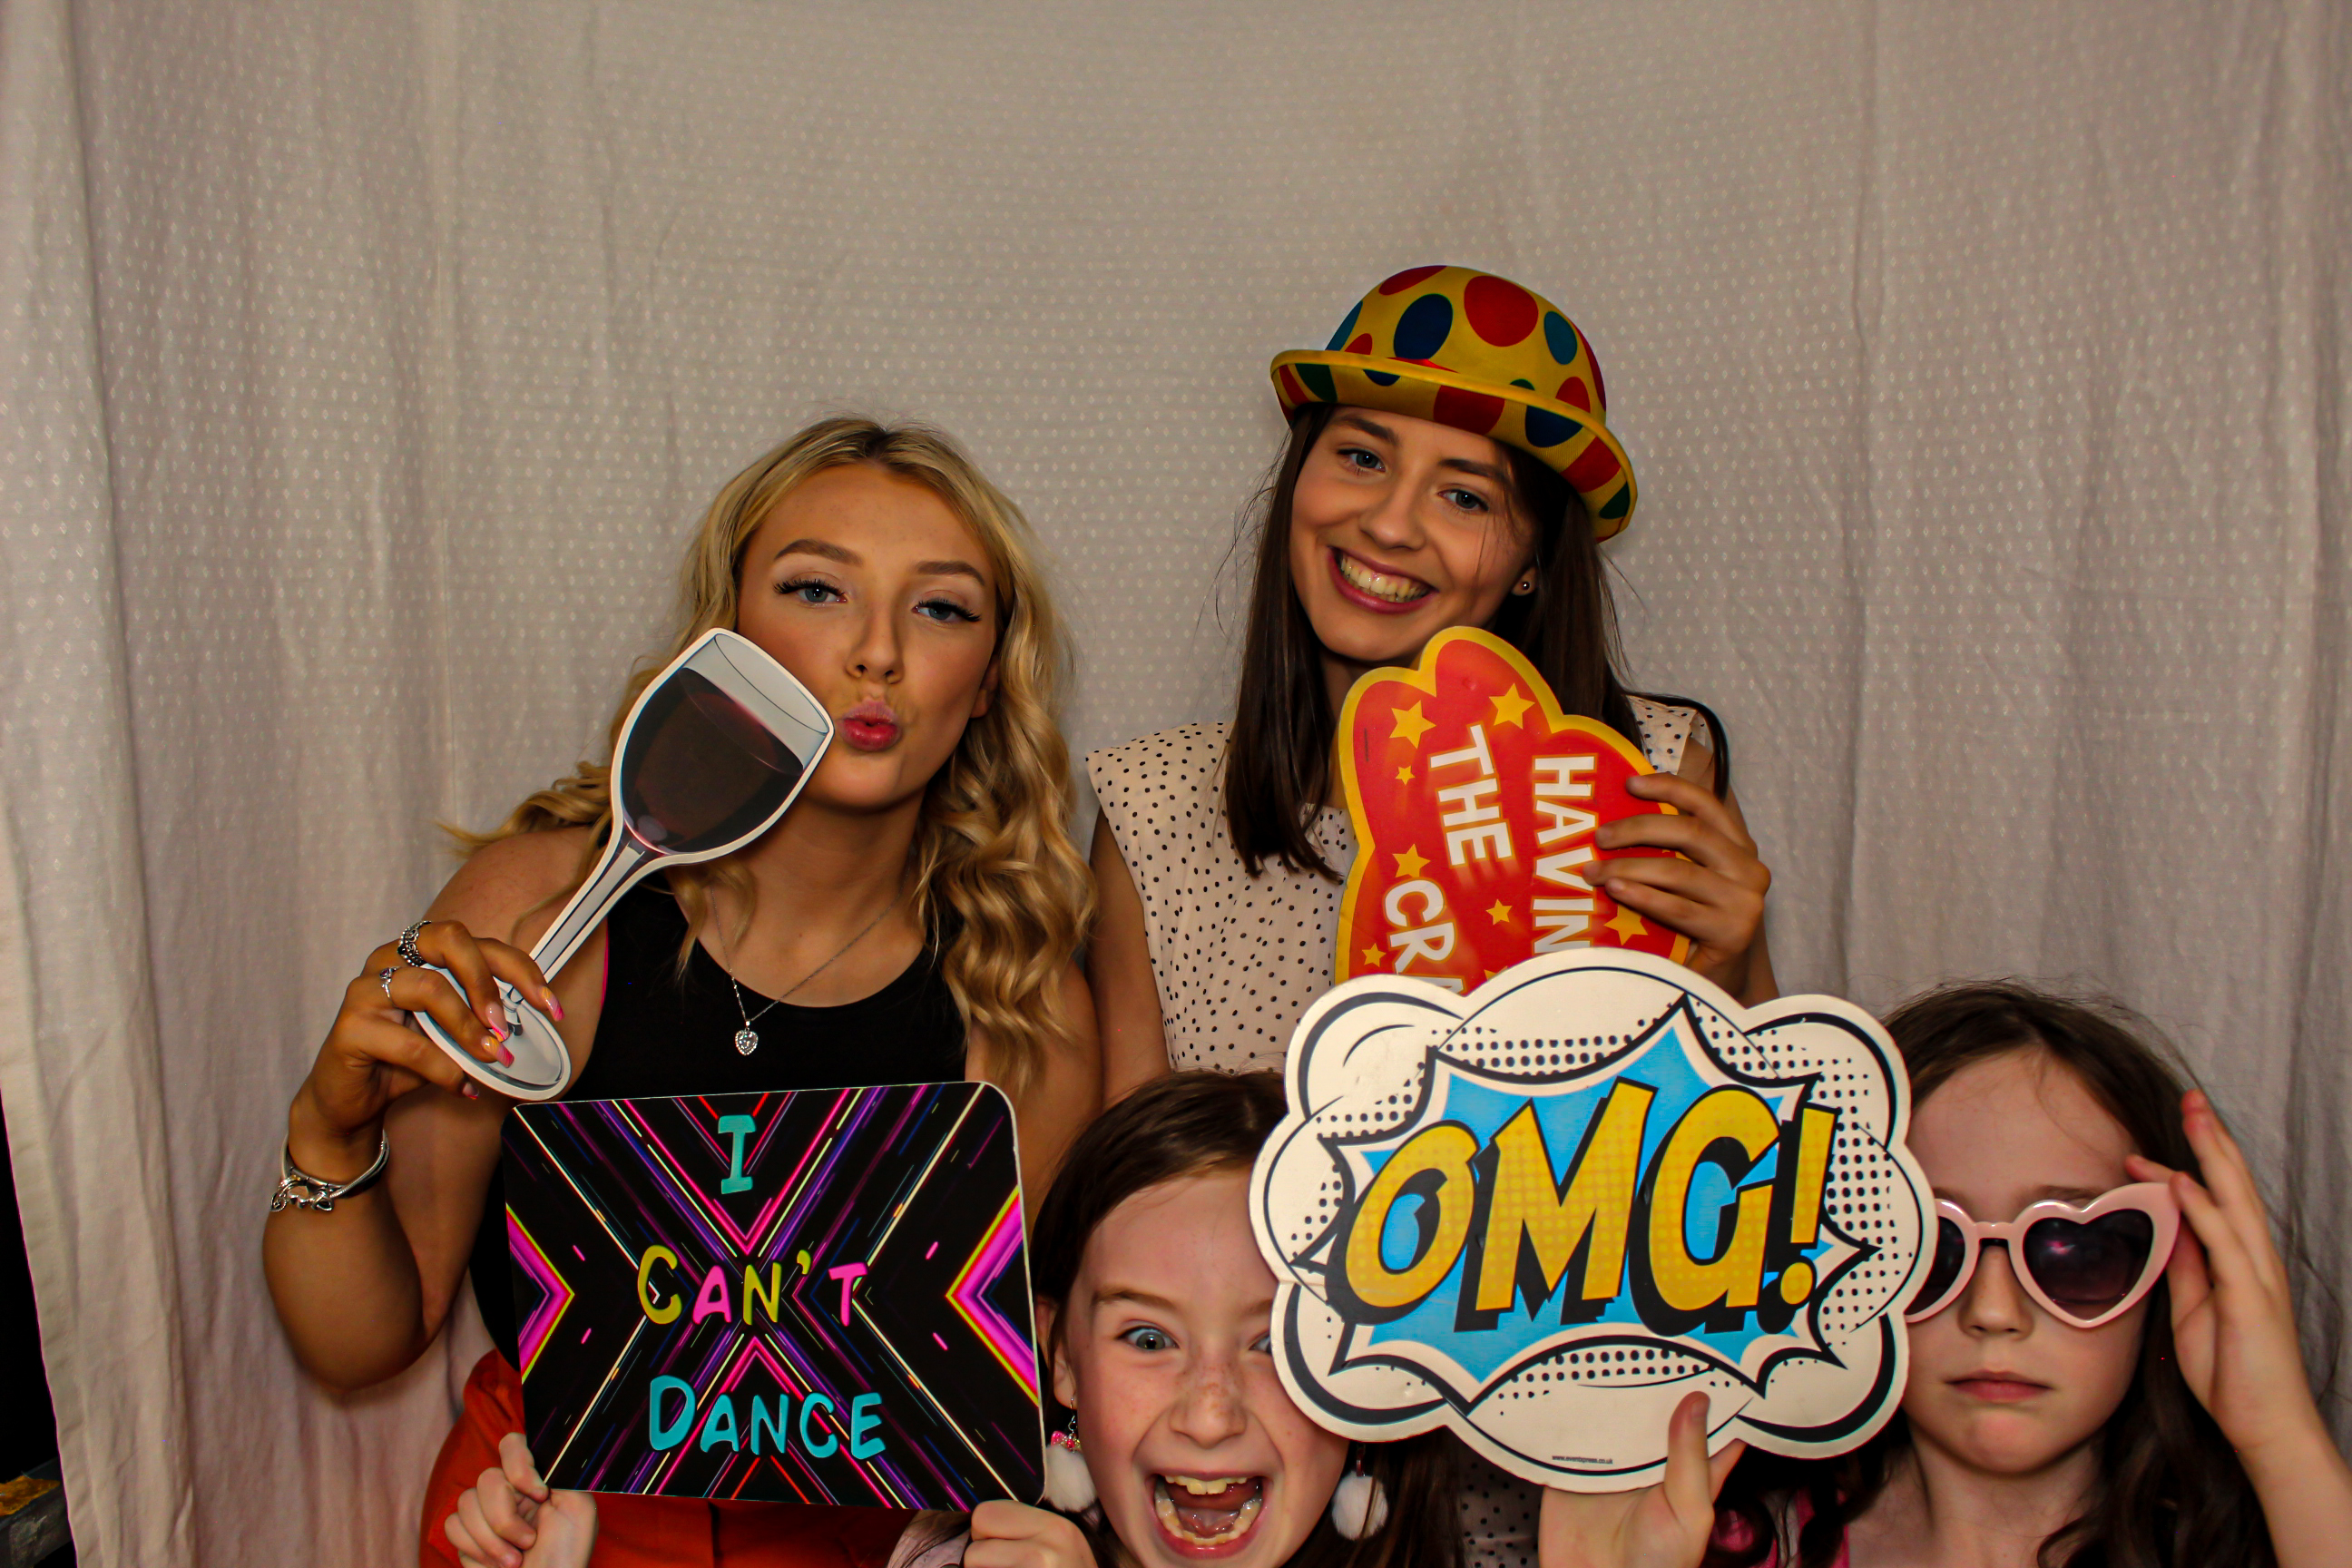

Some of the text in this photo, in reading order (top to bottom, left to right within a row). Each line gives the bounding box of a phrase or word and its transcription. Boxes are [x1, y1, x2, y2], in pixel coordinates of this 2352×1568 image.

[1429, 724, 1514, 867] THE
[717, 1113, 757, 1195] I
[1336, 1077, 1840, 1329] OMG!
[637, 1244, 868, 1328] CAN'T
[648, 1374, 887, 1461] DANCE
